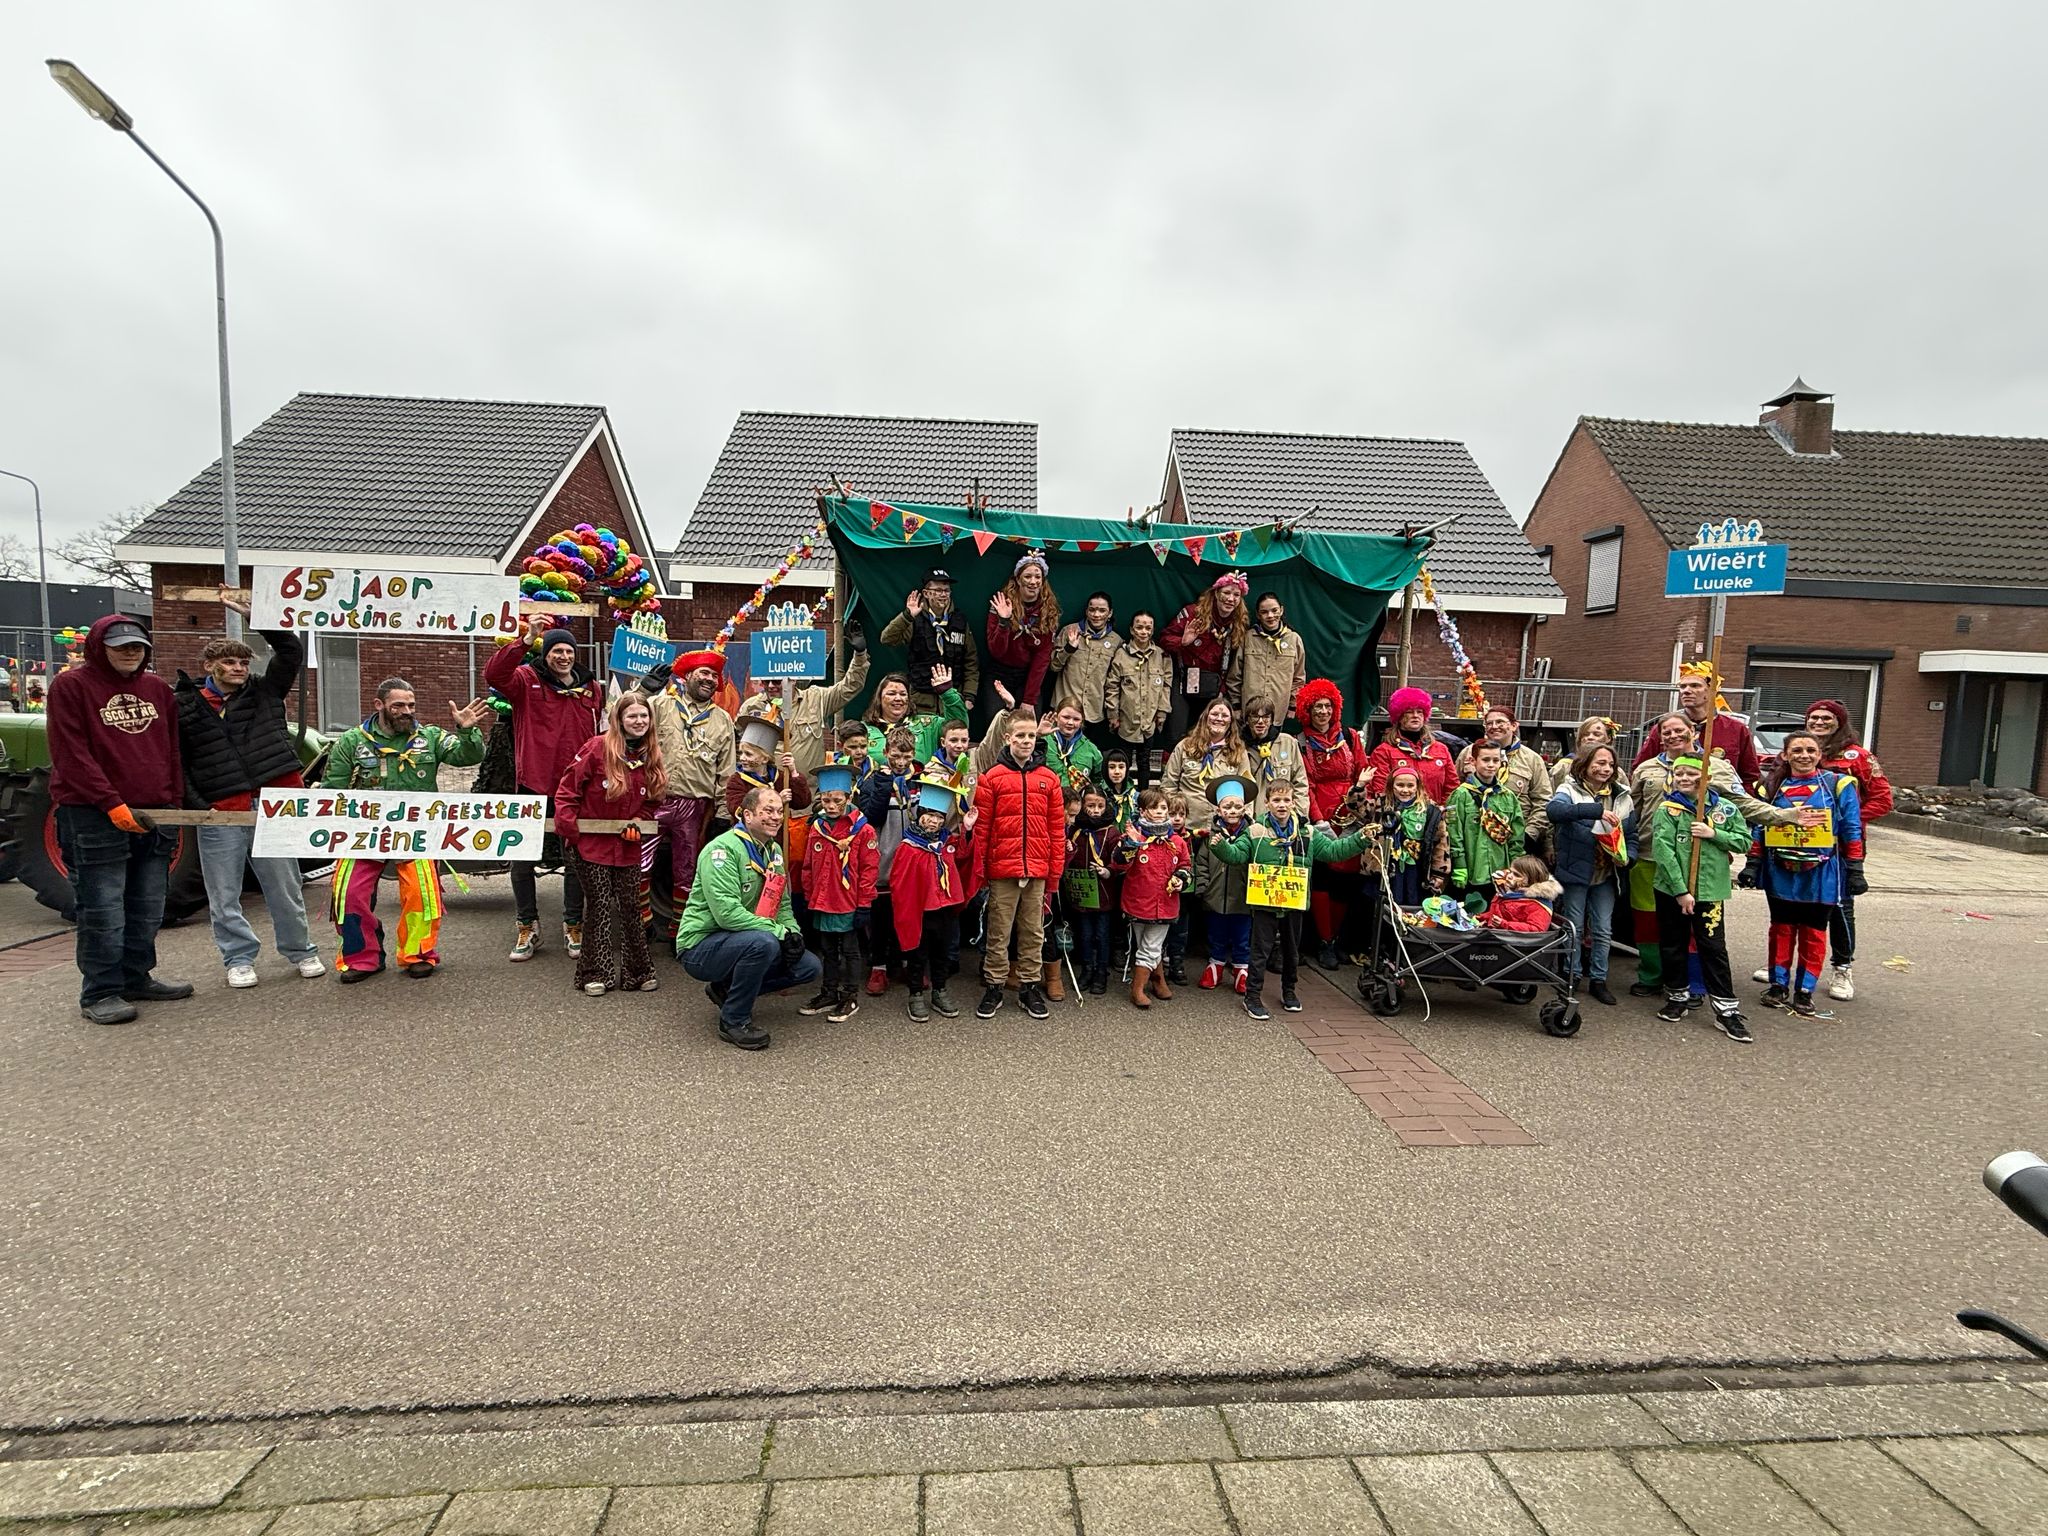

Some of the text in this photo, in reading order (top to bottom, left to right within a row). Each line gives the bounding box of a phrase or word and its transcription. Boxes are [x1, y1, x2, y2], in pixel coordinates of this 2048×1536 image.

[1687, 551, 1767, 572] Wieërt
[281, 567, 334, 601] 65
[1694, 576, 1753, 590] Luueke
[463, 601, 518, 633] job
[626, 636, 666, 662] Wieërt
[762, 636, 812, 654] Wieërt
[768, 660, 805, 673] Luueke
[262, 798, 309, 818] VAE
